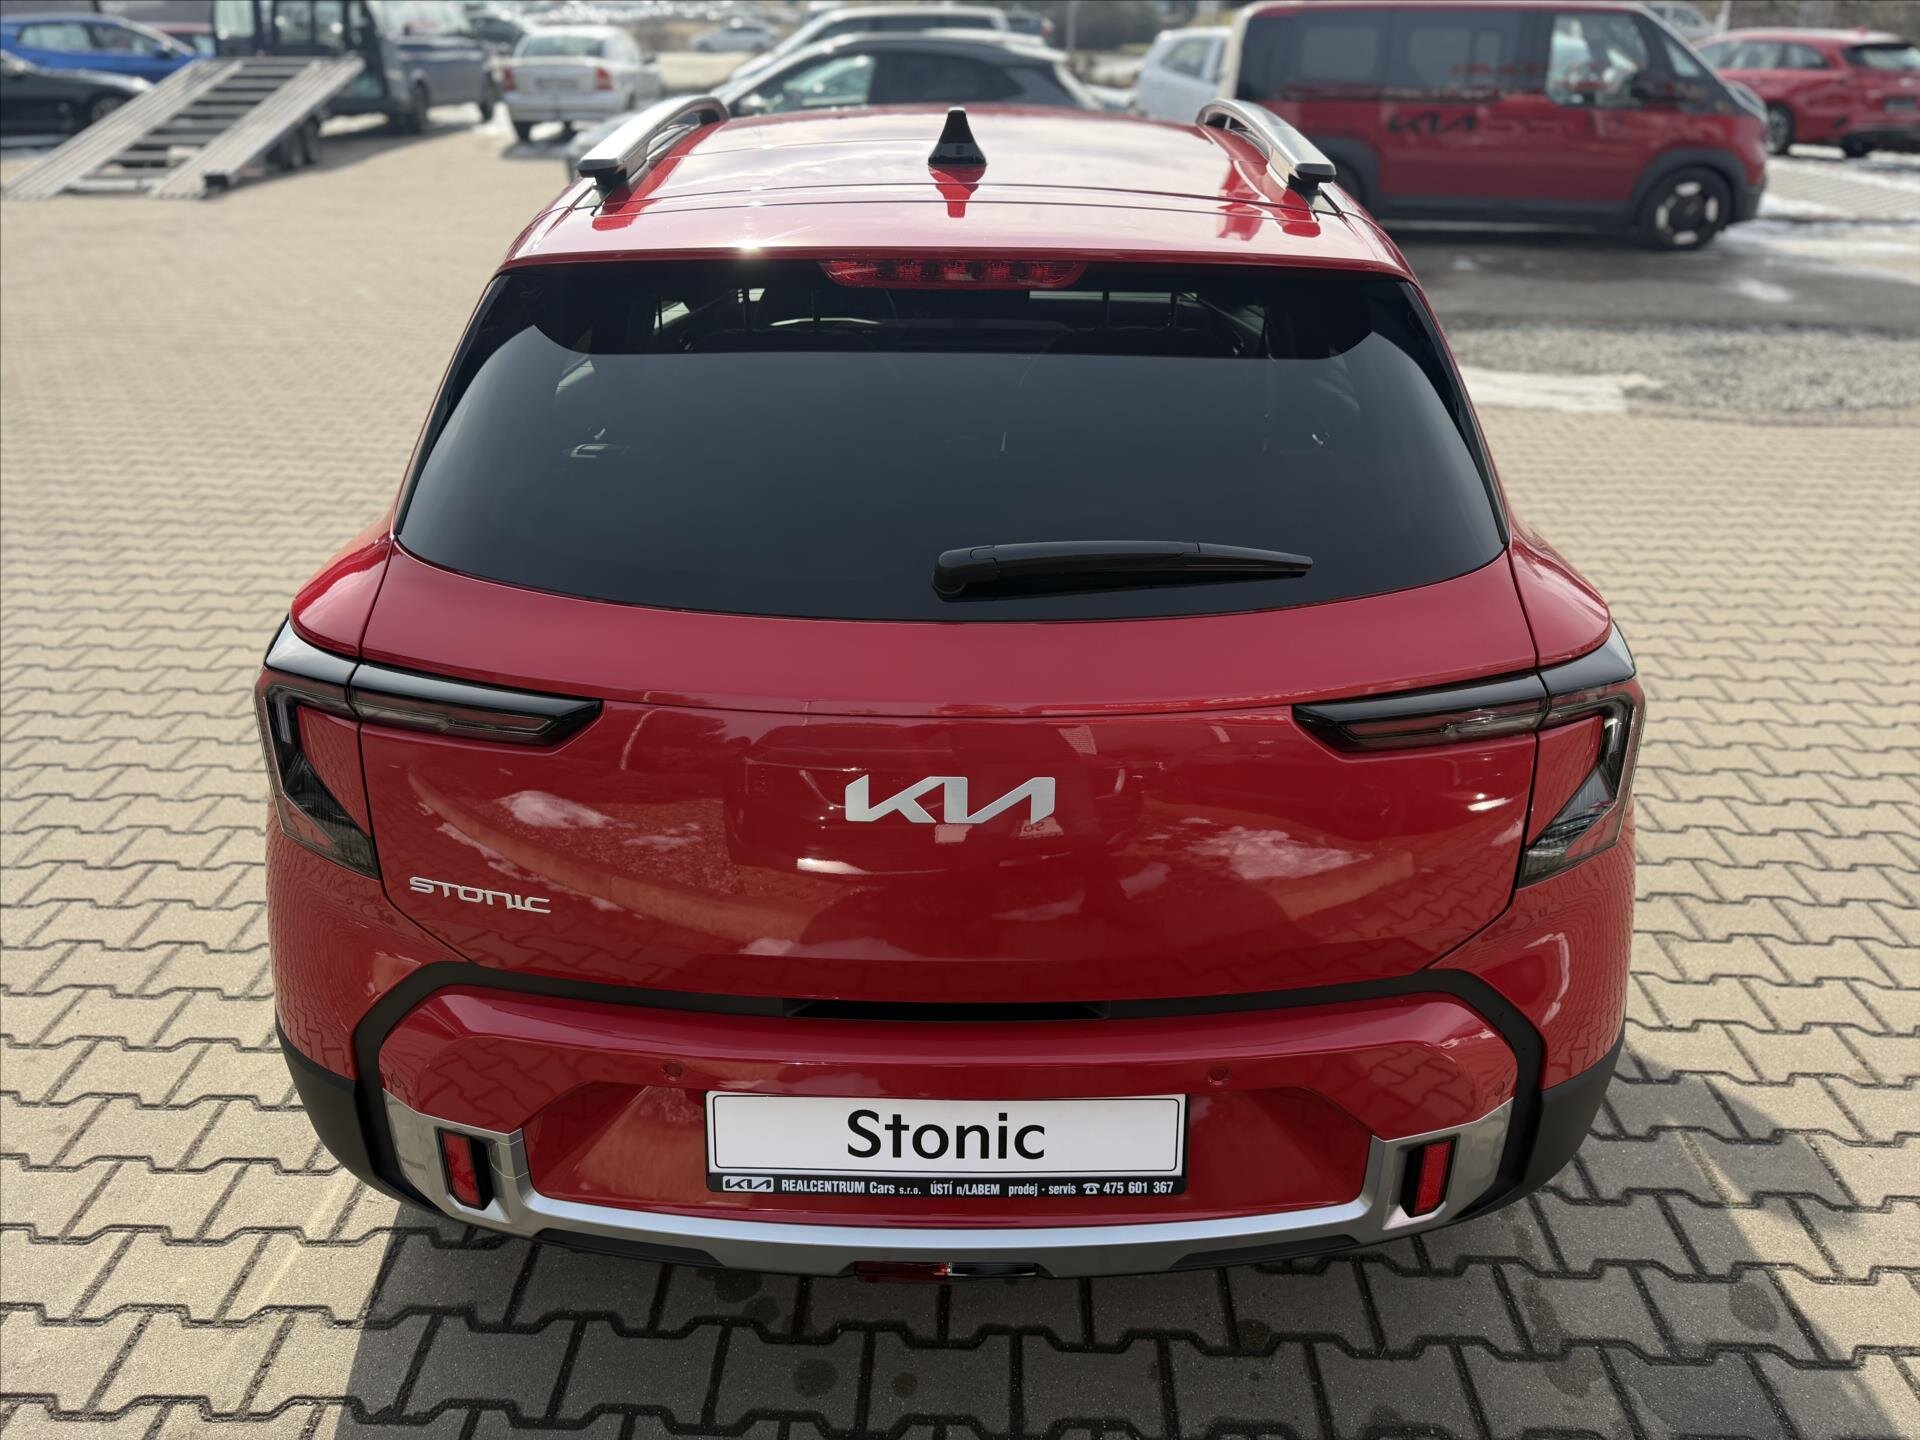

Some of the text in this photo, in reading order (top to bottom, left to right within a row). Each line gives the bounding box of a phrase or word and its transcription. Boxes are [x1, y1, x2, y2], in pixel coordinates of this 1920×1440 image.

[409, 876, 551, 914] STONIC
[847, 1109, 1045, 1160] Stonic
[781, 1179, 865, 1193] REALCENTRUM
[869, 1183, 895, 1194] Cars
[899, 1187, 921, 1195] s.r.o.
[930, 1181, 953, 1195] ÚSTÍ
[956, 1183, 1000, 1196] n/LABEM
[1008, 1183, 1039, 1197] prodej
[1048, 1183, 1077, 1195] servis
[1103, 1182, 1124, 1194] 475
[1128, 1182, 1148, 1194] 601
[1153, 1181, 1174, 1193] 367
